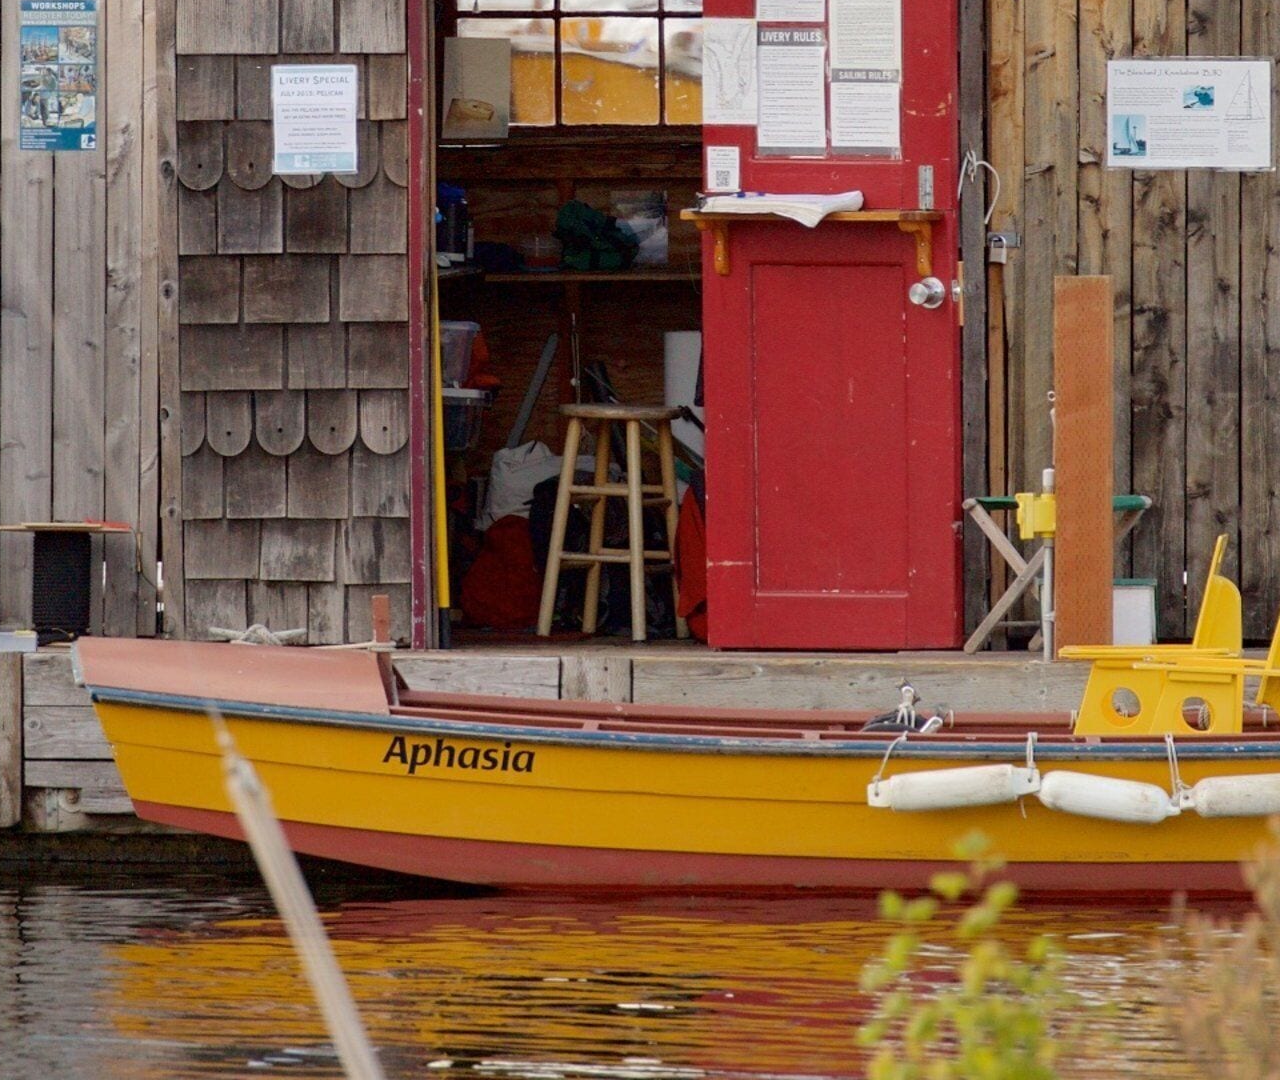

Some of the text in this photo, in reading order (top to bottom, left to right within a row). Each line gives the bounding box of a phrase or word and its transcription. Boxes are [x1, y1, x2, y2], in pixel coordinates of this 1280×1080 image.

[30, 1, 86, 10] WORKSHOPS
[760, 31, 822, 43] LIVERY RULES
[279, 75, 350, 85] LIVERY SPECIAL
[838, 71, 892, 80] SAILING RULES
[382, 735, 536, 775] Aphasia
